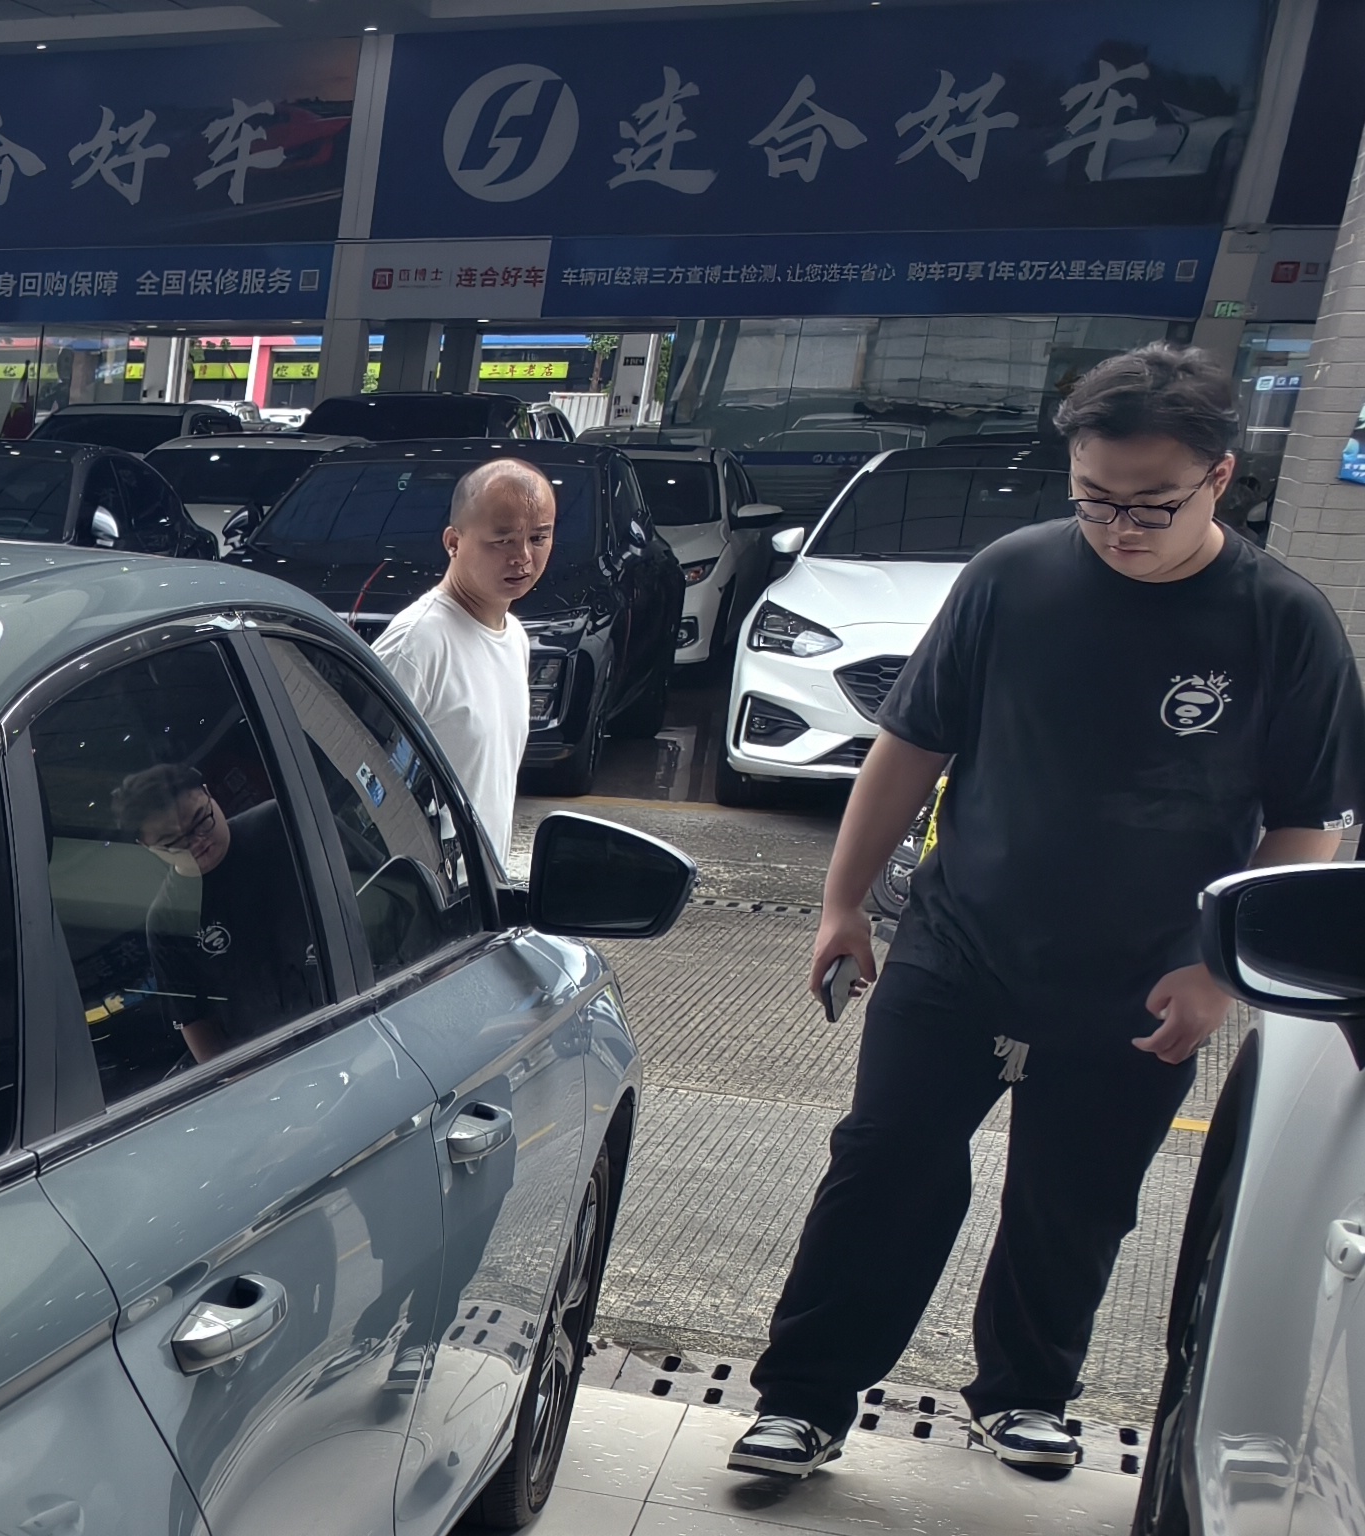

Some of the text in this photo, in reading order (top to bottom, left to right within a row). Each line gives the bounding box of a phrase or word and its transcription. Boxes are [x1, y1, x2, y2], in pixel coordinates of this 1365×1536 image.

[608, 59, 1156, 194] 连合好车
[135, 268, 292, 297] 全国保修服务
[455, 266, 546, 288] 连合好车
[560, 259, 1165, 287] 车辆可经第三方查博士检测、让您选车省心 购车可享1年3万公里全国保修
[480, 363, 554, 377] 三年老店
